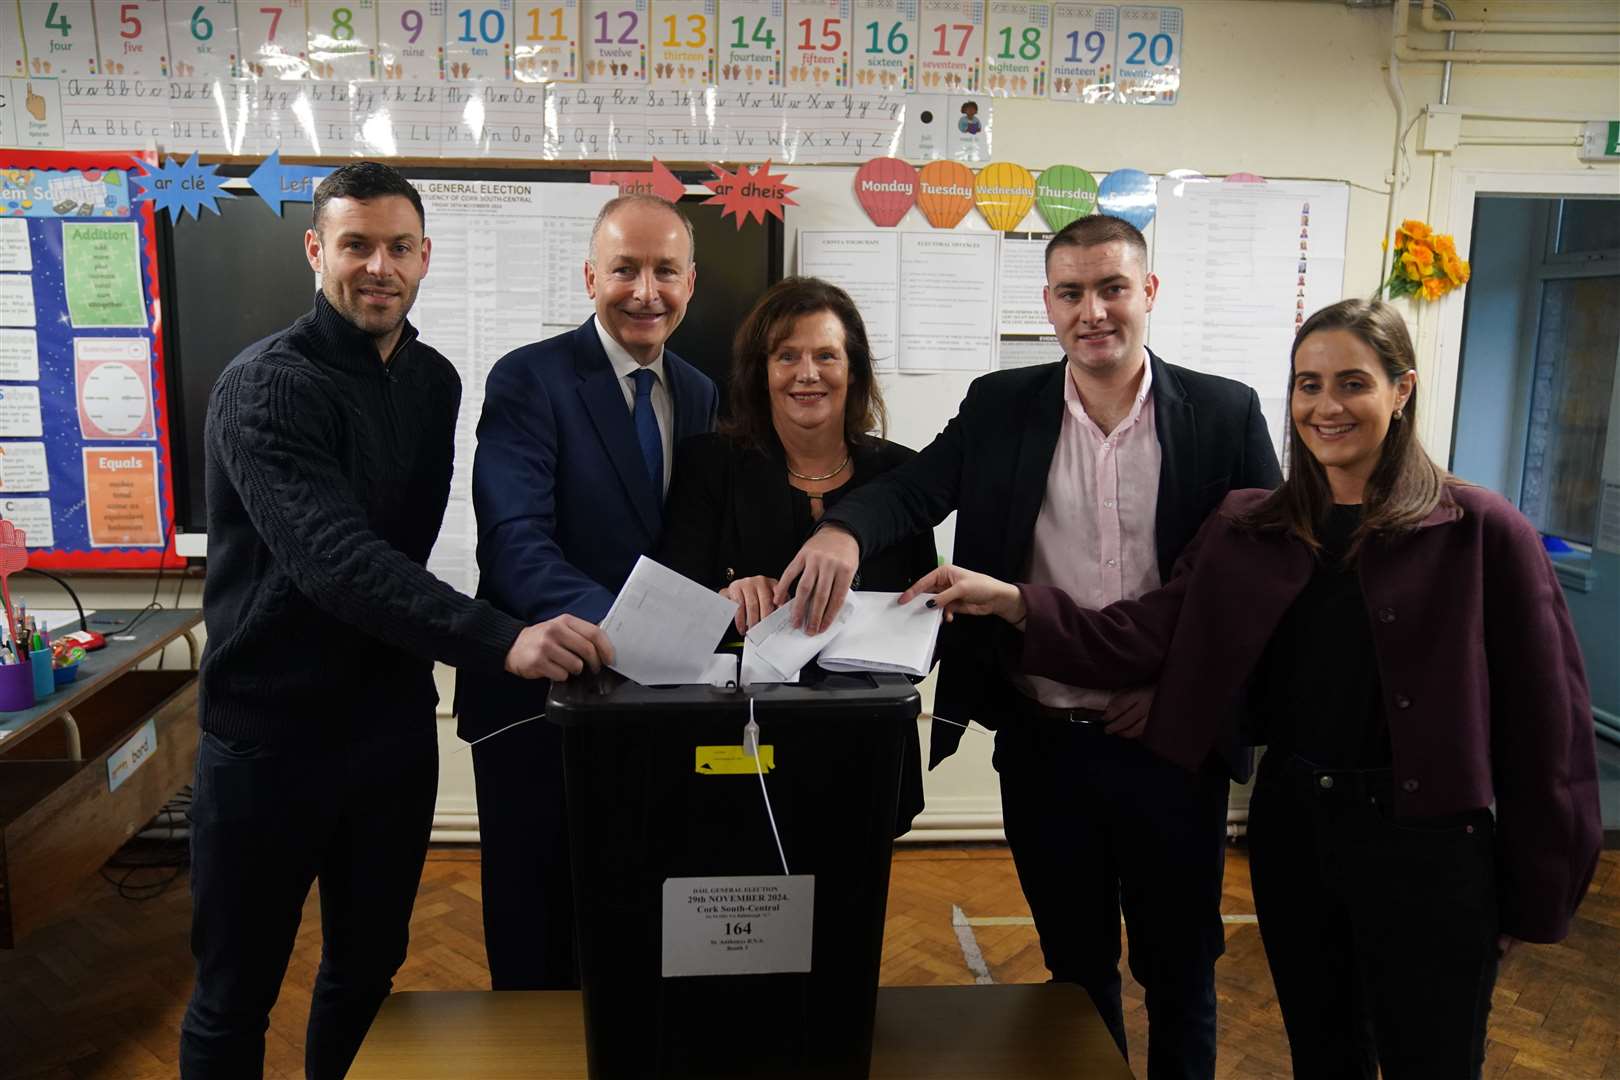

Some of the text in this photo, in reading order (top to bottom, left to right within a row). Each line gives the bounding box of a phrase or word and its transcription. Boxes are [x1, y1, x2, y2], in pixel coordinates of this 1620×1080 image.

[44, 2, 72, 37] 4
[120, 4, 142, 40] 5
[191, 5, 213, 41] 6
[259, 7, 283, 42] 7
[331, 7, 354, 41] 8
[401, 9, 423, 44] 9
[458, 8, 505, 44] 10
[526, 7, 568, 42] 11
[594, 10, 639, 45] 12
[662, 13, 707, 49] 13
[730, 15, 776, 49] 14
[797, 17, 842, 52] 15
[865, 21, 909, 55] 16
[50, 40, 73, 54] four
[122, 40, 144, 54] five
[931, 24, 975, 56] 17
[997, 26, 1041, 61] 18
[1064, 30, 1106, 64] 19
[196, 45, 212, 54] six
[402, 46, 425, 58] nine
[471, 46, 488, 57] ten
[599, 47, 632, 58] twelve
[663, 51, 704, 61] thirteen
[1125, 32, 1173, 67] 20
[729, 53, 772, 64] fourteen
[801, 54, 835, 65] fifteen
[867, 58, 903, 68] sixteen
[922, 61, 966, 70] seventeen
[988, 62, 1029, 73] eighteen
[1054, 66, 1095, 76] nineteen
[154, 176, 206, 190] ar clé
[280, 175, 312, 193] Lef
[428, 183, 477, 194] GENERAL
[480, 184, 532, 195] ELECTION
[861, 180, 913, 196] Monday
[920, 182, 973, 199] Tuesday
[715, 183, 785, 200] ar dheis
[976, 185, 1034, 199] Wednesday
[1038, 185, 1097, 204] Thursday
[73, 228, 128, 241] Addition
[99, 456, 144, 472] Equals
[688, 895, 706, 904] 29th
[709, 894, 765, 903] NOVEMBER
[697, 903, 780, 913] Cork South-Central
[726, 922, 752, 936] 164
